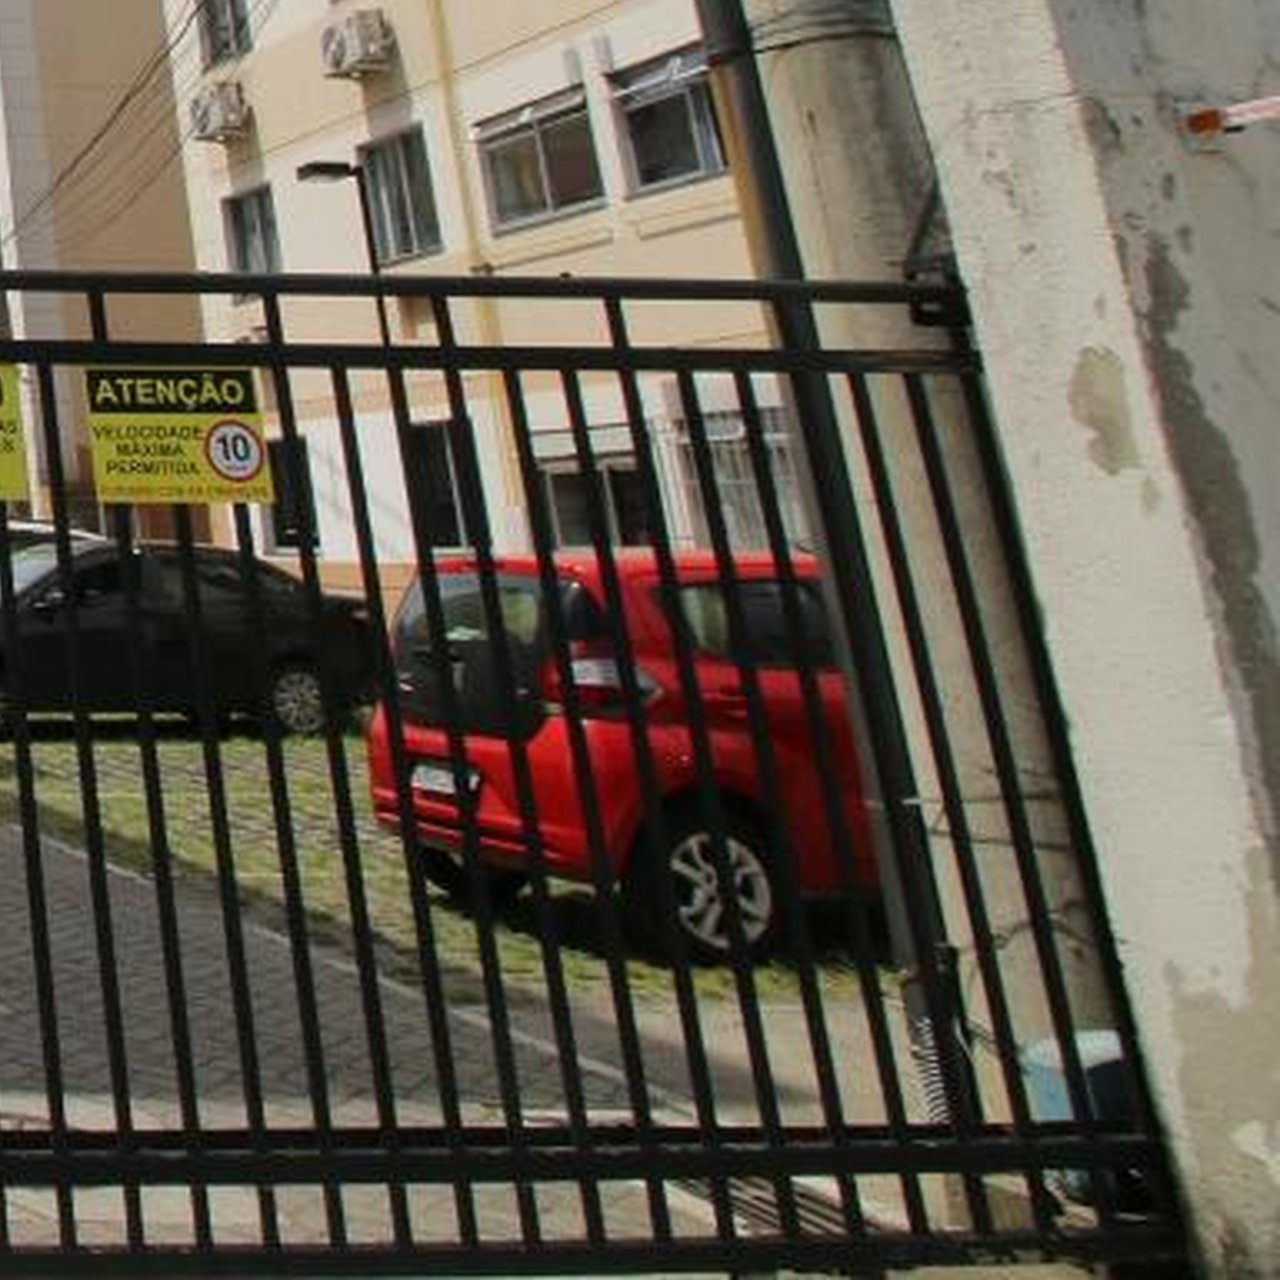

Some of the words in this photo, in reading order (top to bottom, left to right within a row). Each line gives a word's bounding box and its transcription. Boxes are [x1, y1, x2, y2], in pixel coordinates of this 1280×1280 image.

[94, 373, 245, 410] ATENÇÃO
[92, 424, 205, 441] VELOCIDADE
[216, 433, 251, 463] 10
